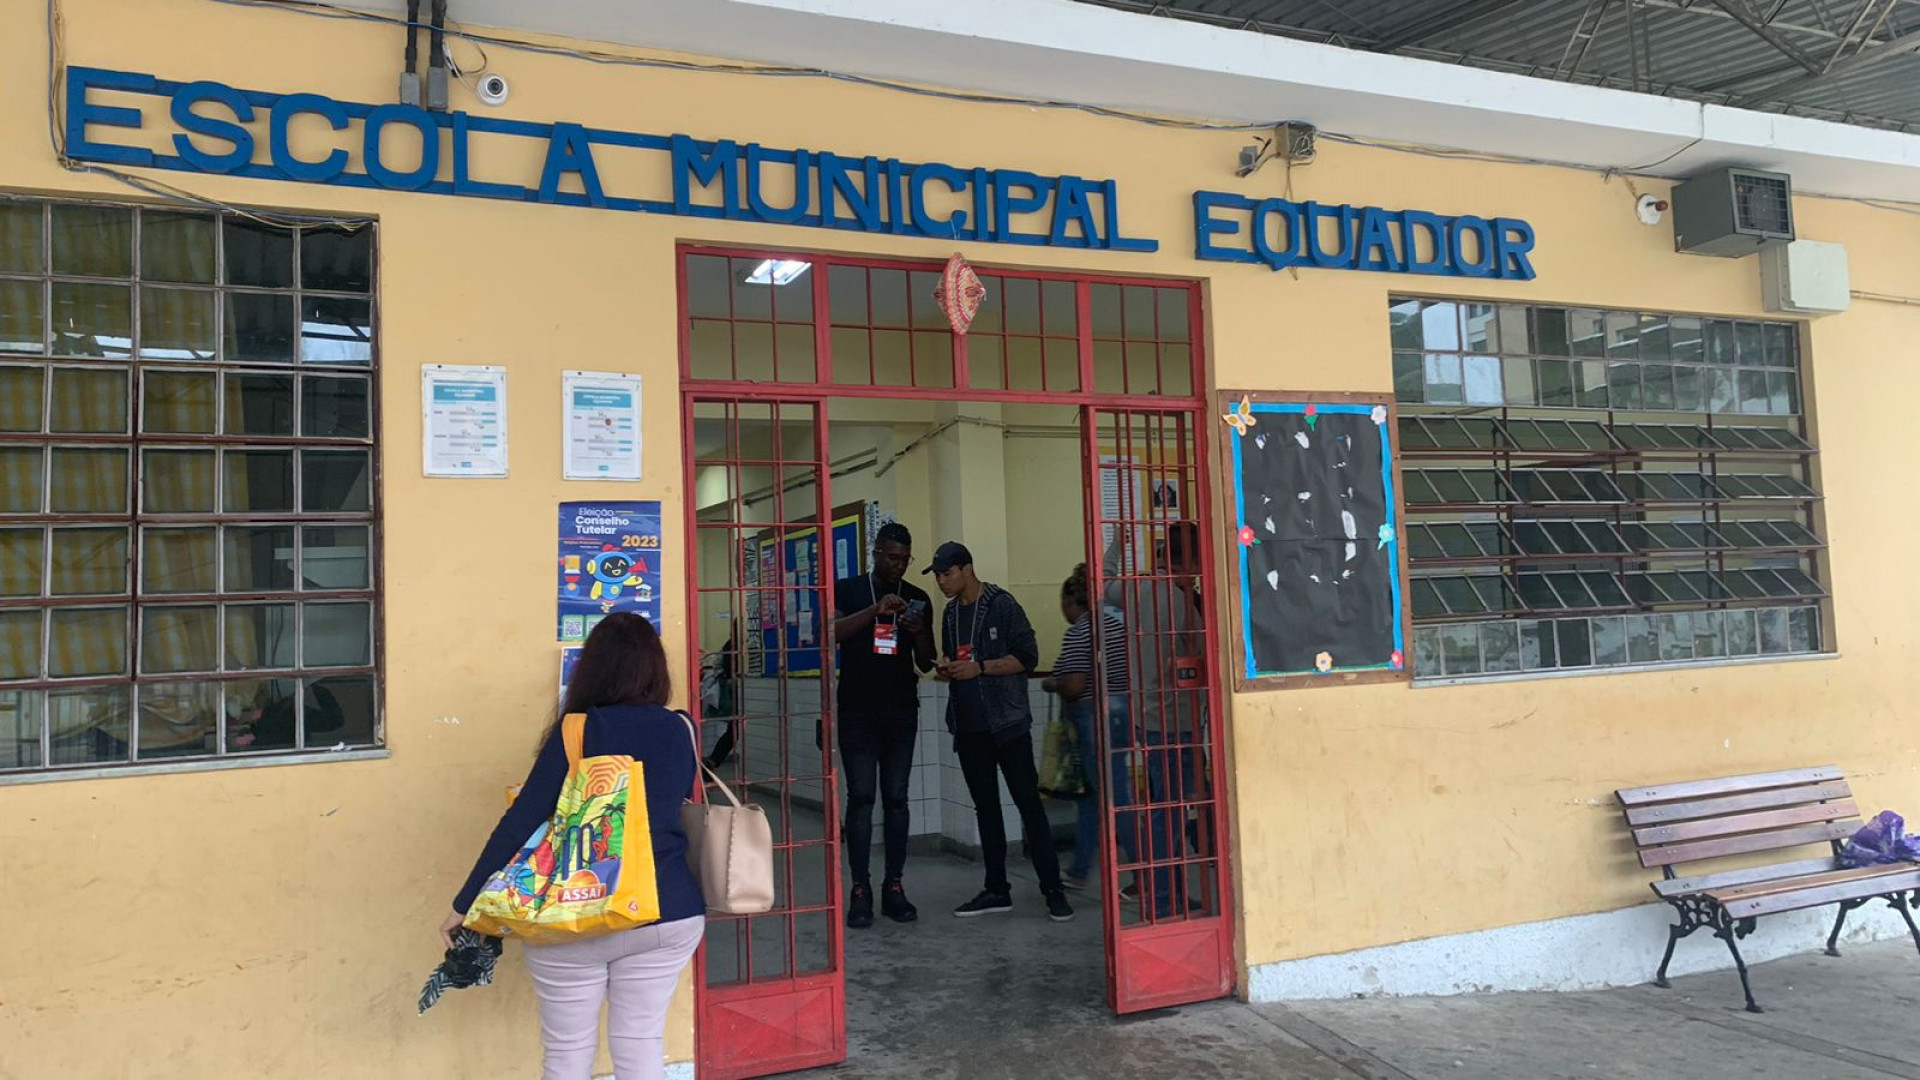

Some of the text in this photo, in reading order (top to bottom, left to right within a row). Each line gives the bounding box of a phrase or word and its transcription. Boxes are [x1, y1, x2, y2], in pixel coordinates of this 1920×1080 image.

[66, 66, 1537, 281] ESCOLA MUNICIPAL EQUADOR
[578, 507, 614, 518] Eleição
[575, 516, 630, 526] Conselho
[575, 525, 617, 535] Tutelar
[622, 535, 658, 547] 2023
